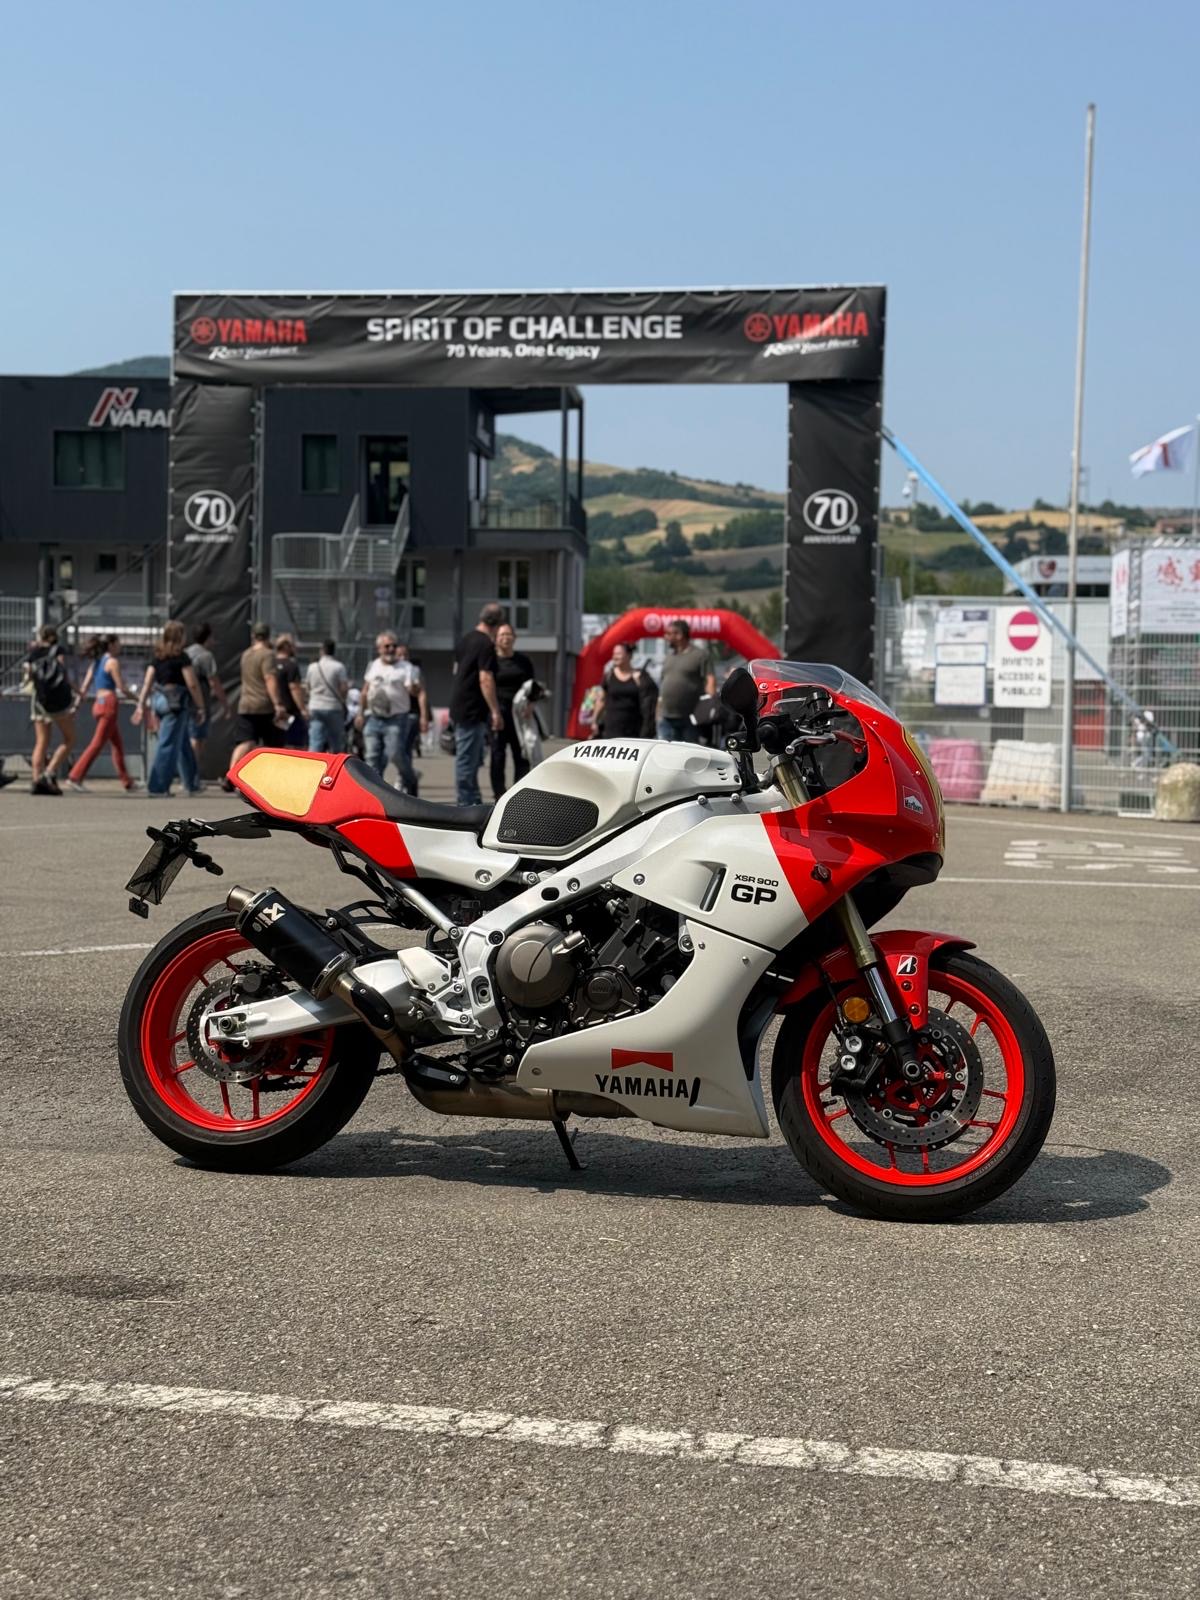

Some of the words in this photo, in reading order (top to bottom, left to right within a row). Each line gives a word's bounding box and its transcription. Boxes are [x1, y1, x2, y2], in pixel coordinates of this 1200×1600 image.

[217, 319, 307, 343] YAMAHA
[366, 316, 458, 341] SPIRIT
[463, 316, 503, 340] OF
[509, 315, 683, 340] CHALLENGE
[772, 310, 868, 341] YAMAHA
[446, 343, 466, 358] 70
[468, 344, 513, 359] Years,
[515, 344, 545, 357] One
[547, 344, 600, 360] Legacy
[194, 497, 226, 526] 70
[813, 496, 848, 527] 70
[573, 745, 640, 761] YAMAHA
[734, 873, 756, 883] XSR
[757, 877, 779, 887] 900
[730, 883, 777, 905] GP
[594, 1073, 689, 1098] YAMAHA
